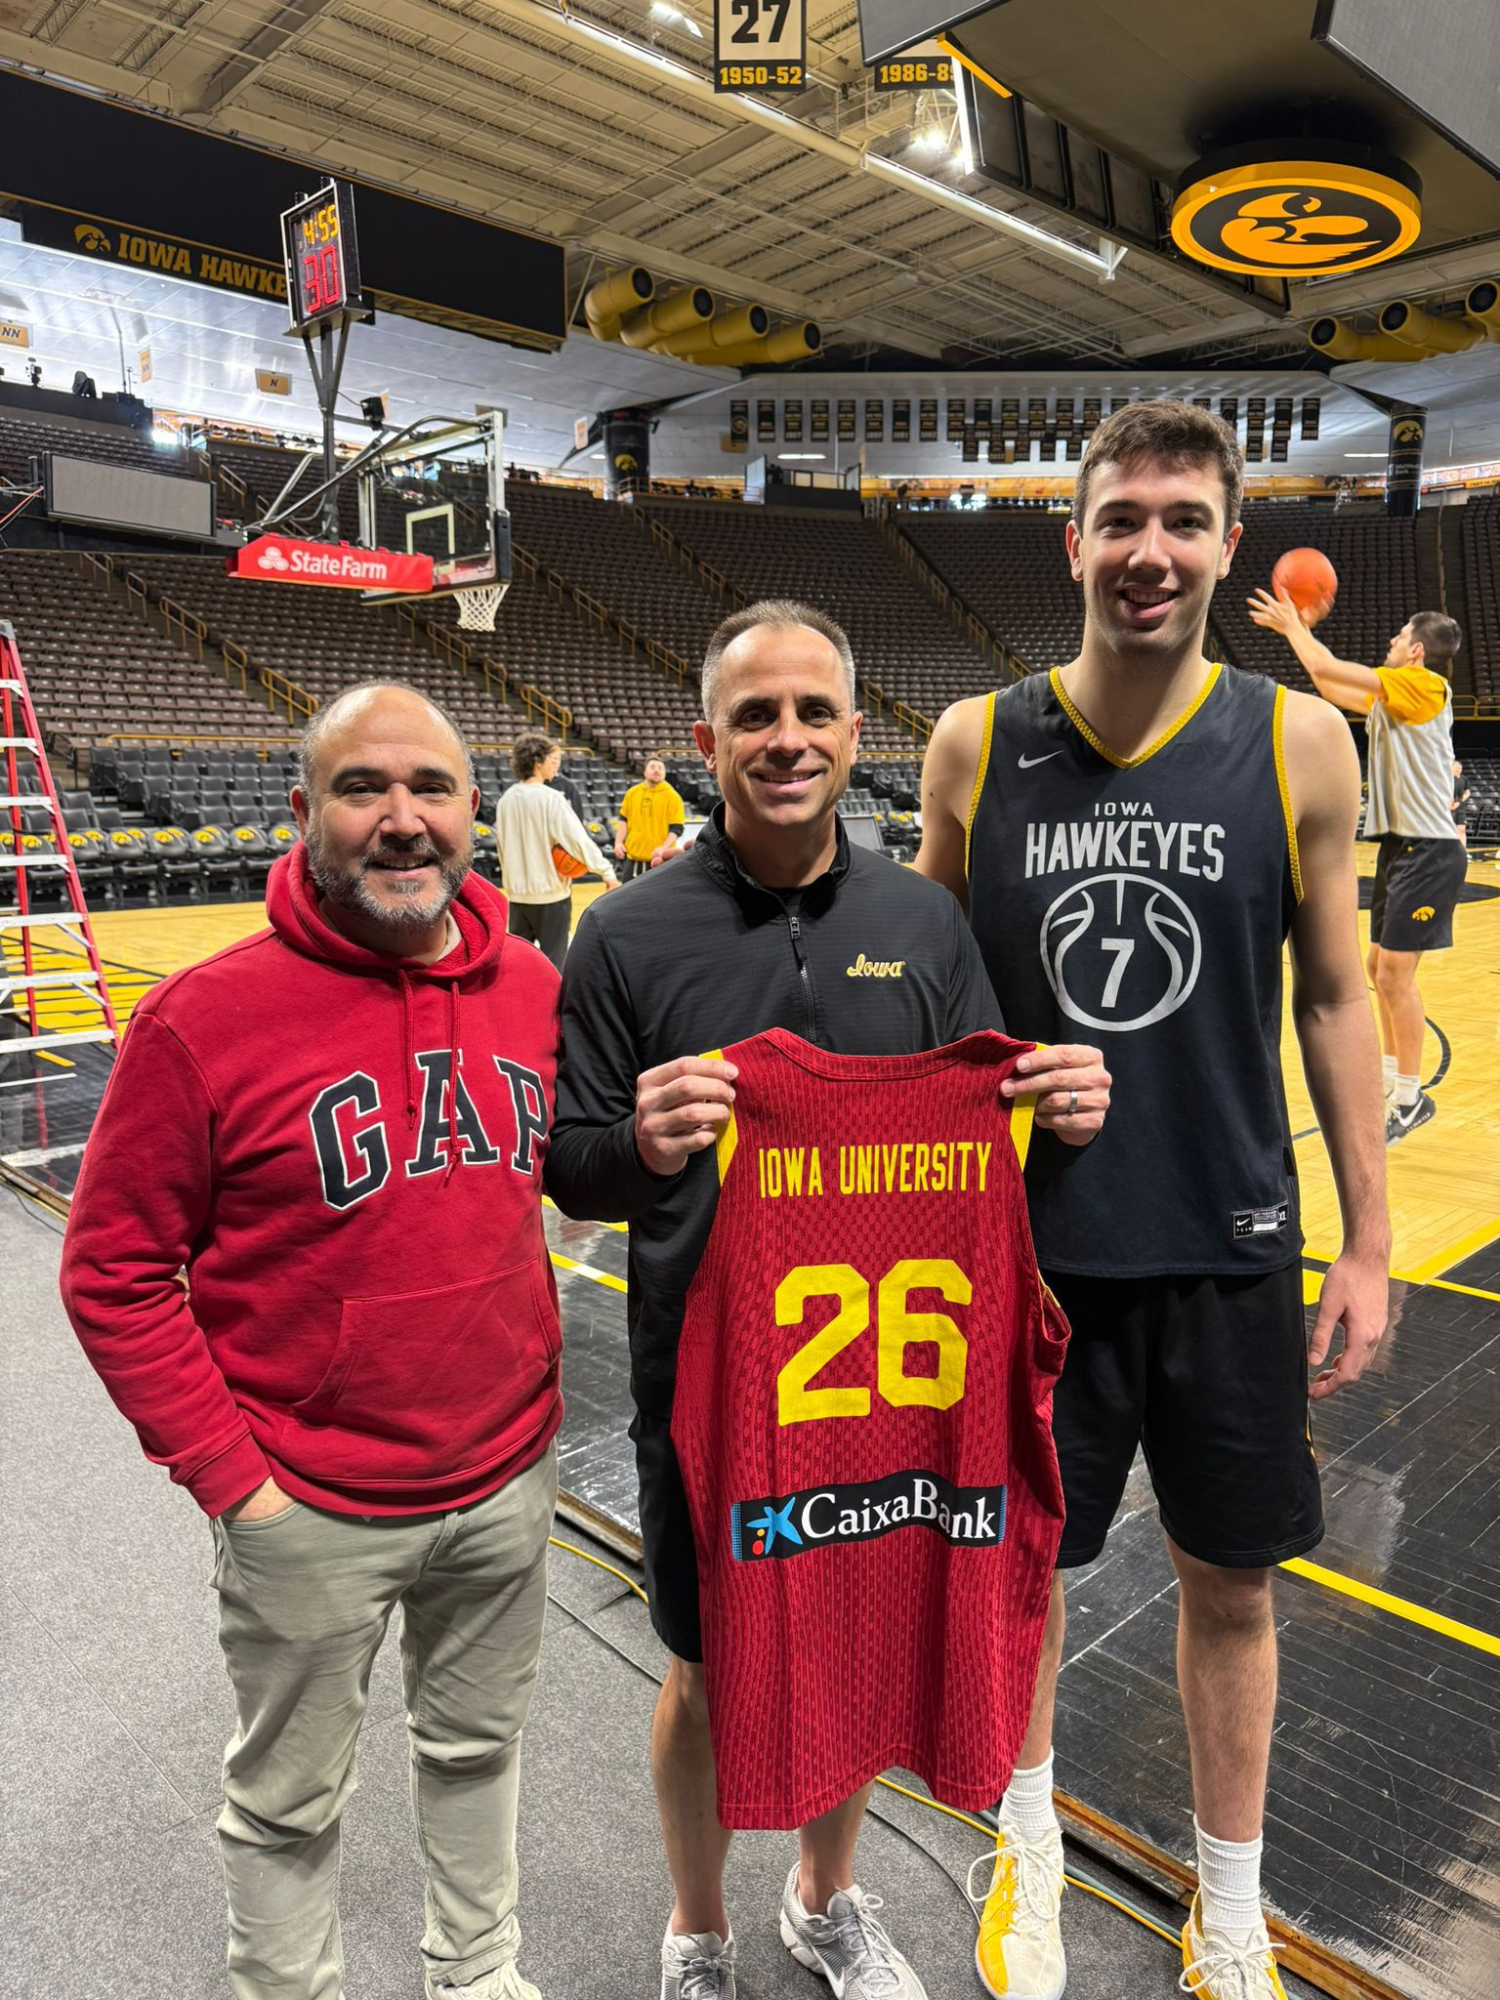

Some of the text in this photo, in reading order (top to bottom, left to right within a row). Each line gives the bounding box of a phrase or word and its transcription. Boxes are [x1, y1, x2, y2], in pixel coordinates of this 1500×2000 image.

[731, 0, 791, 43] 27
[720, 66, 802, 86] 1950-52
[303, 204, 339, 246] 4:55
[117, 232, 191, 275] IOWA
[303, 244, 340, 313] 30
[1, 326, 20, 338] NN
[269, 377, 278, 388] N
[1095, 802, 1154, 817] IOWA
[1025, 821, 1226, 882] HAWKEYES
[846, 953, 906, 977] Iowa
[1101, 938, 1135, 1008] 7
[308, 1049, 549, 1212] GAP
[759, 1142, 992, 1198] IOWA UNIVERSITY
[775, 1259, 973, 1427] 26
[801, 1478, 996, 1539] CaixaBank
